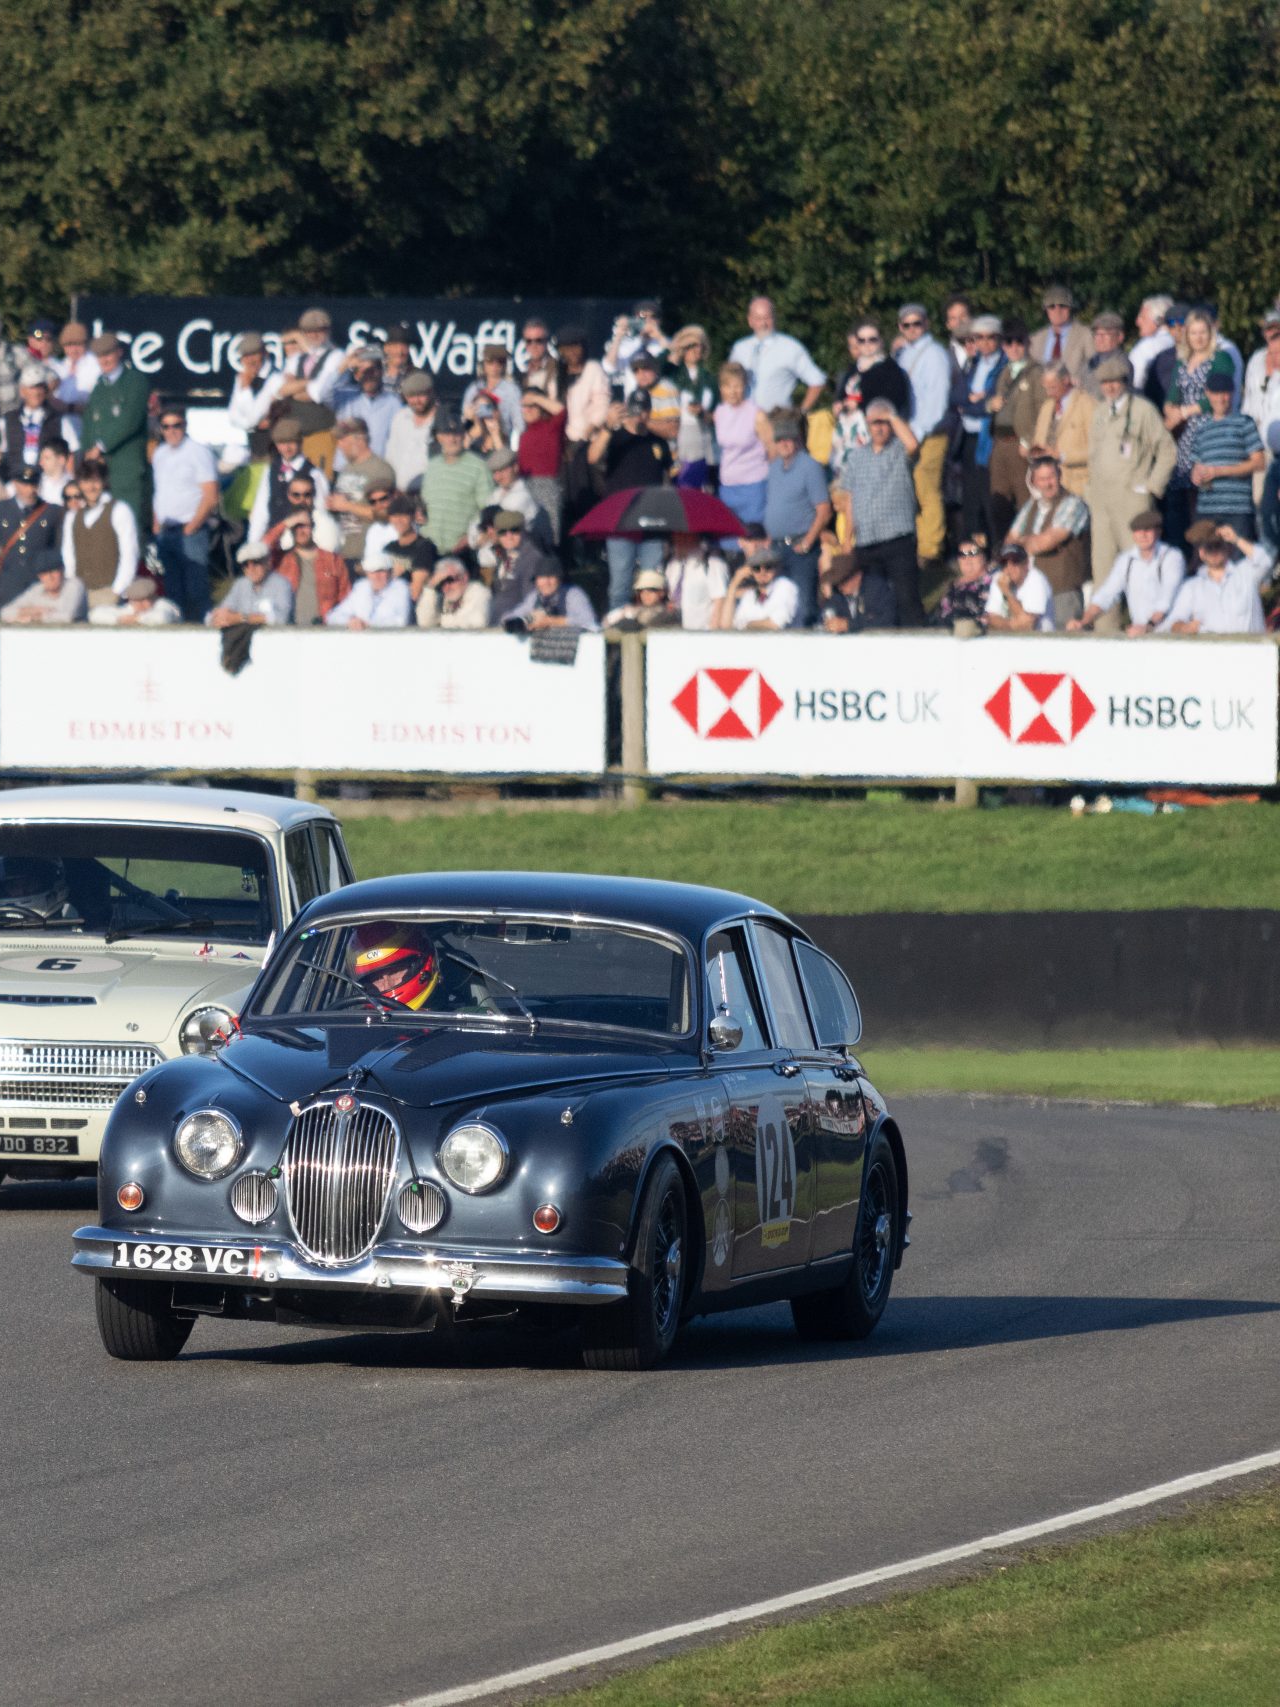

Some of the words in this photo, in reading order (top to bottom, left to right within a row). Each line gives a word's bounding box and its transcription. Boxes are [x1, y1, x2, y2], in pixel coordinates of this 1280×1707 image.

[177, 318, 286, 374] Crea
[409, 319, 559, 375] Waffle
[794, 689, 887, 723] HSBC
[896, 690, 941, 724] UK
[1108, 696, 1202, 730] HSBC
[1211, 696, 1256, 731] UK
[68, 719, 235, 741] EDMISTON
[371, 721, 534, 744] EDMISTON
[36, 957, 82, 971] 6
[33, 1138, 69, 1153] 832
[757, 1121, 793, 1223] 124
[115, 1243, 194, 1272] 1628
[201, 1247, 245, 1275] VC
